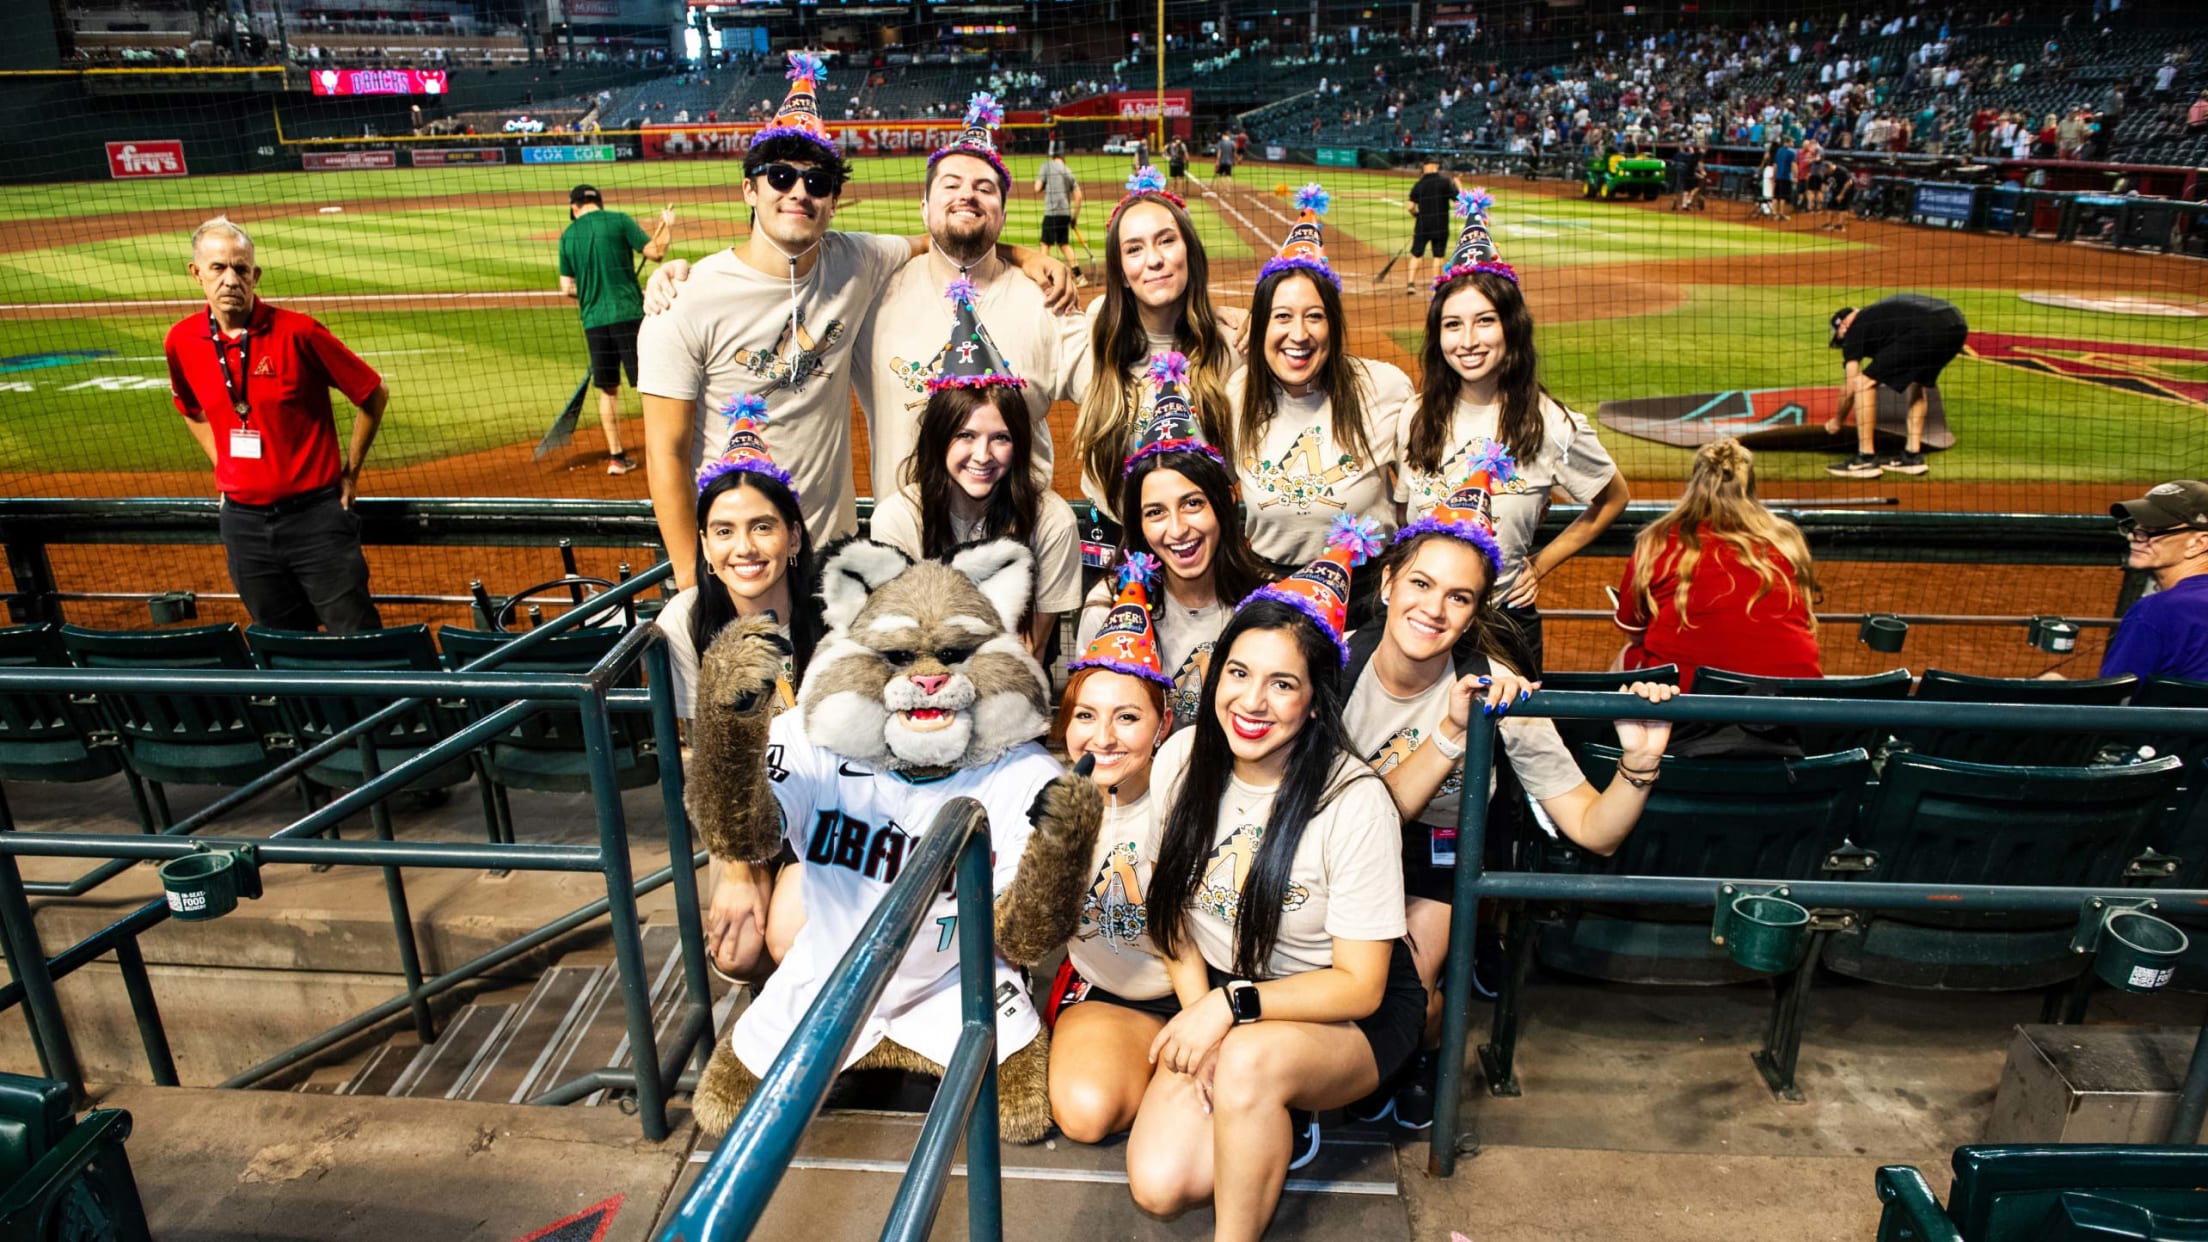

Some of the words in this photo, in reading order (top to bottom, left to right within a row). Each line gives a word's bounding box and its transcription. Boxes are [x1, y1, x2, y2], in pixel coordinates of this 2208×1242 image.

[533, 148, 563, 161] COX
[574, 147, 603, 160] COX
[183, 896, 206, 906] FOOD
